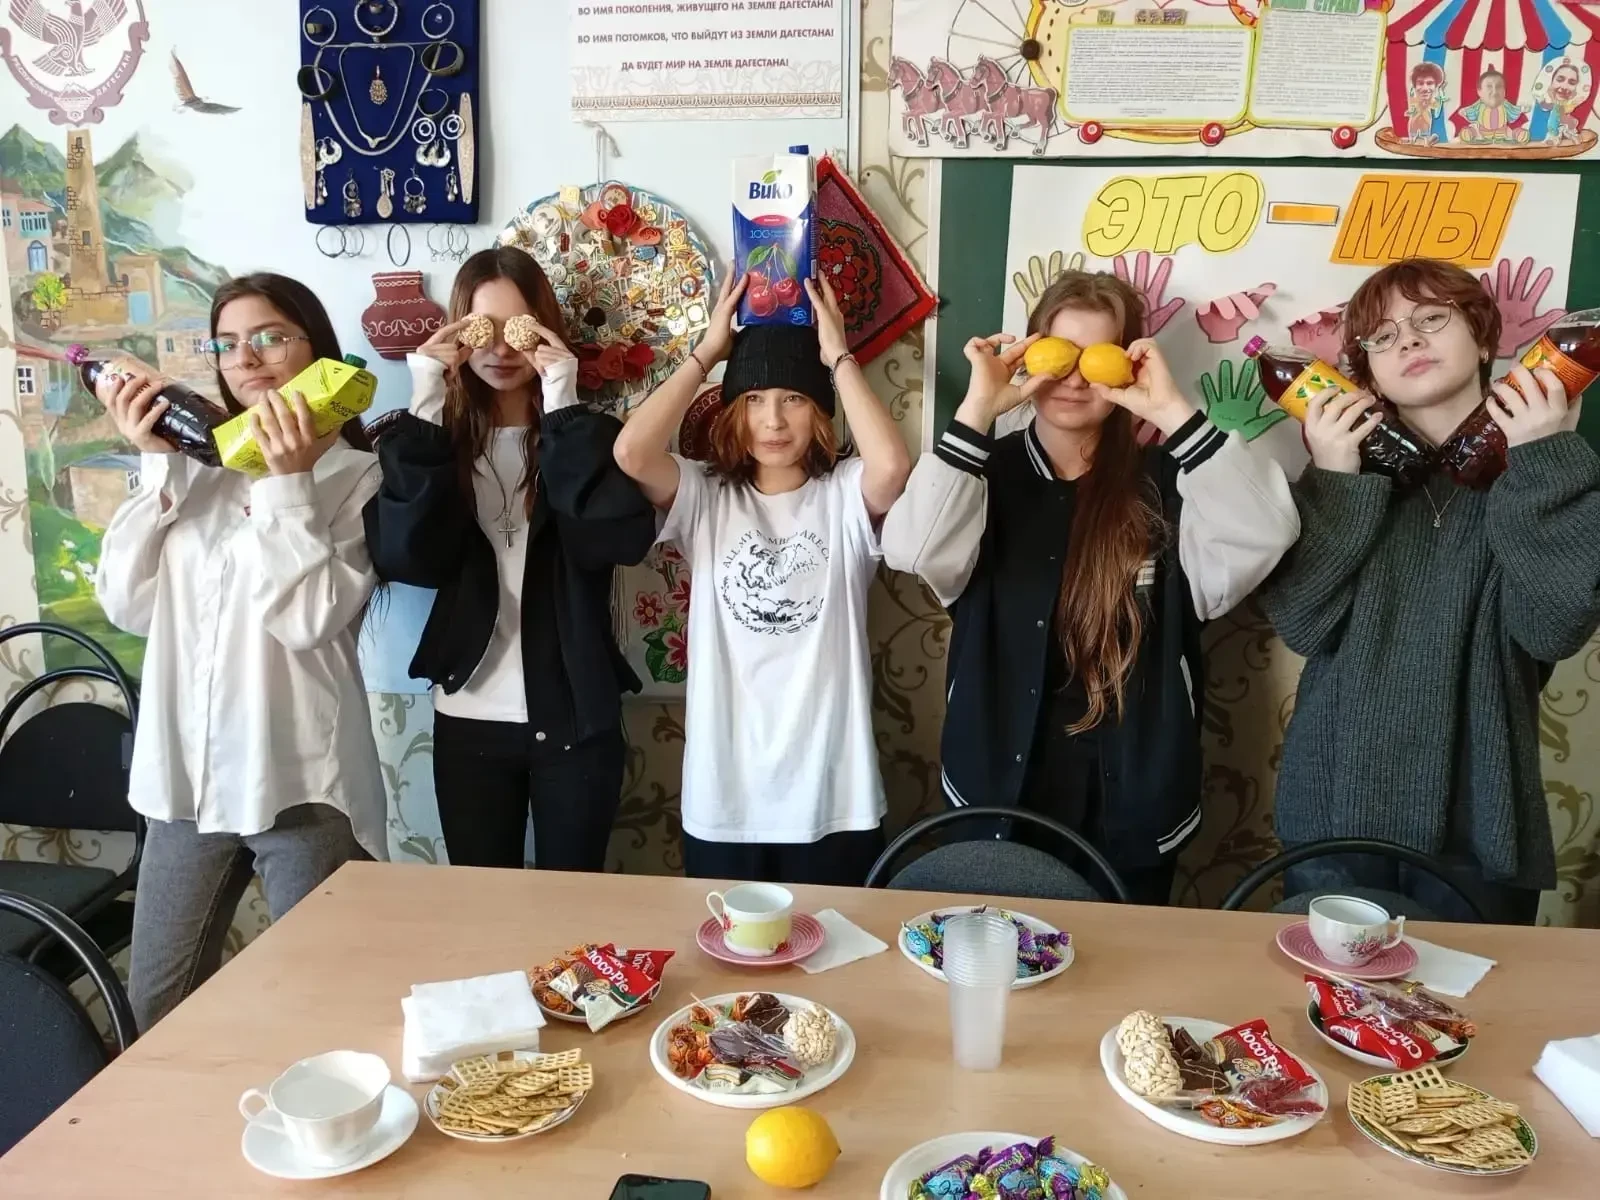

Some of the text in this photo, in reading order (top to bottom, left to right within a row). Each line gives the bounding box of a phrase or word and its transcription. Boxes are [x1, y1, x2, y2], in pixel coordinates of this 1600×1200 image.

[577, 0, 834, 16] ВО ИМЯ ПОКОЛЕНИЯ, ЖИВУЩЕГО НА ЗЕМЛЕ ДАГЕСТАНА!
[577, 28, 834, 44] ВО ИМЯ ПОТОМКОВ, ЧТО ВЫЙДУТ ИЗ ЗЕМЛИ ДАГЕСТАНА!
[621, 58, 789, 72] ДА БУДЕТ МИР НА ЗЕМЛЕ ДАГЕСТАНА!
[1086, 172, 1260, 257] ЭТО
[1338, 180, 1518, 260] МЫ
